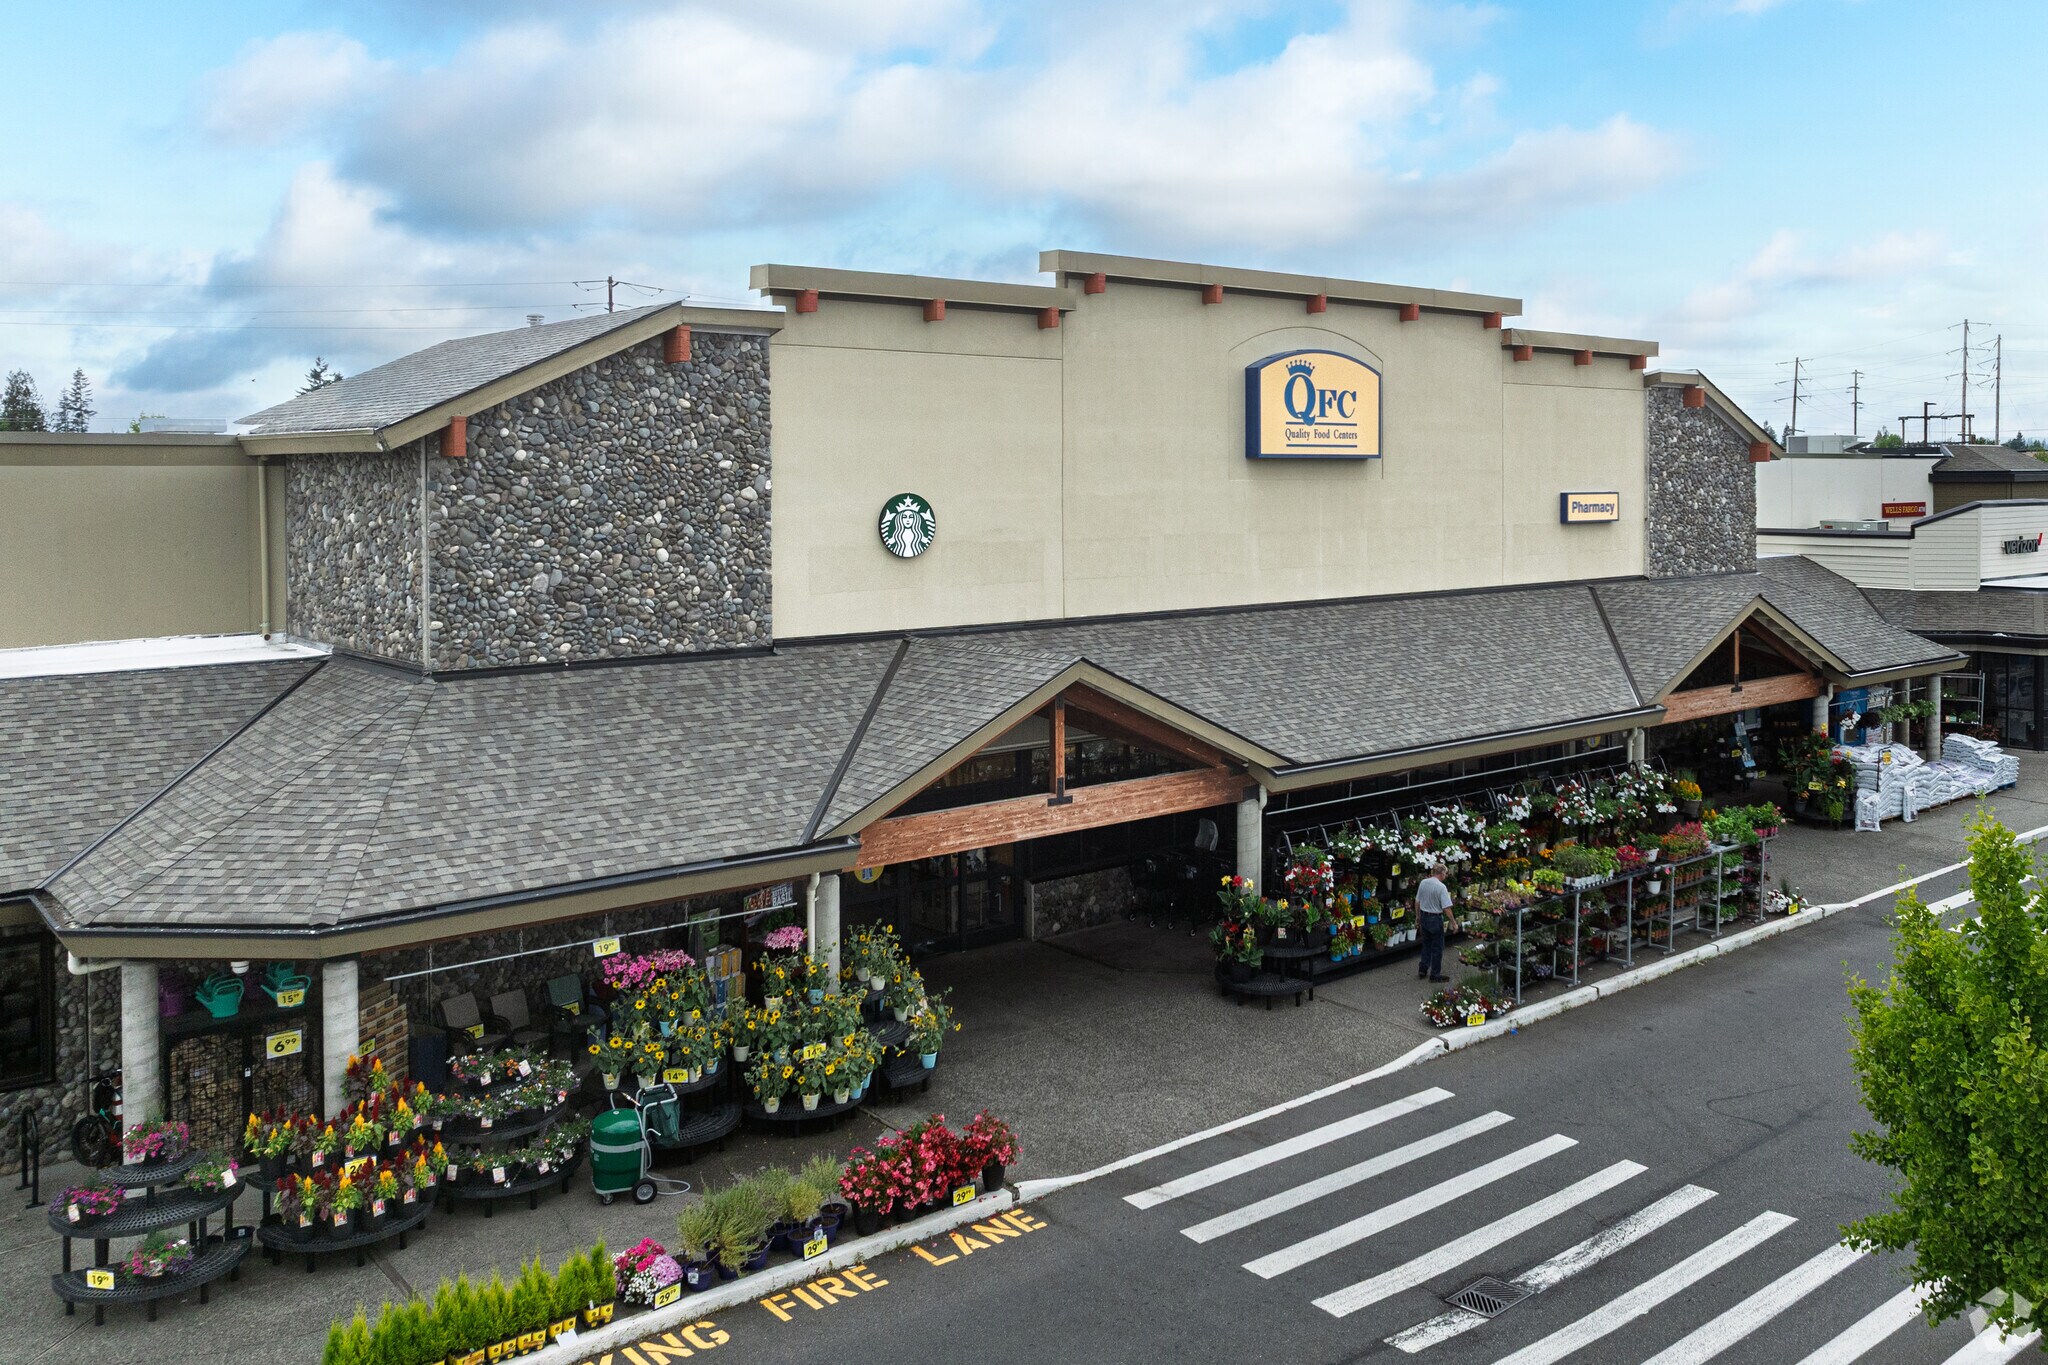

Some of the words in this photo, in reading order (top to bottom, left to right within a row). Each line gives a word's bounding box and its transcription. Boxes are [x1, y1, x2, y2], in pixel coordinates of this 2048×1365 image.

[1284, 374, 1357, 426] QFC
[1285, 428, 1310, 441] Quality
[1314, 429, 1330, 439] Food
[1333, 430, 1358, 440] Centers
[1572, 501, 1615, 515] Pharmacy
[1902, 505, 1918, 513] FARGO
[2004, 535, 2038, 554] verizon
[773, 890, 792, 907] BASIL
[760, 1265, 889, 1322] FIRE
[911, 1208, 1047, 1266] LANE
